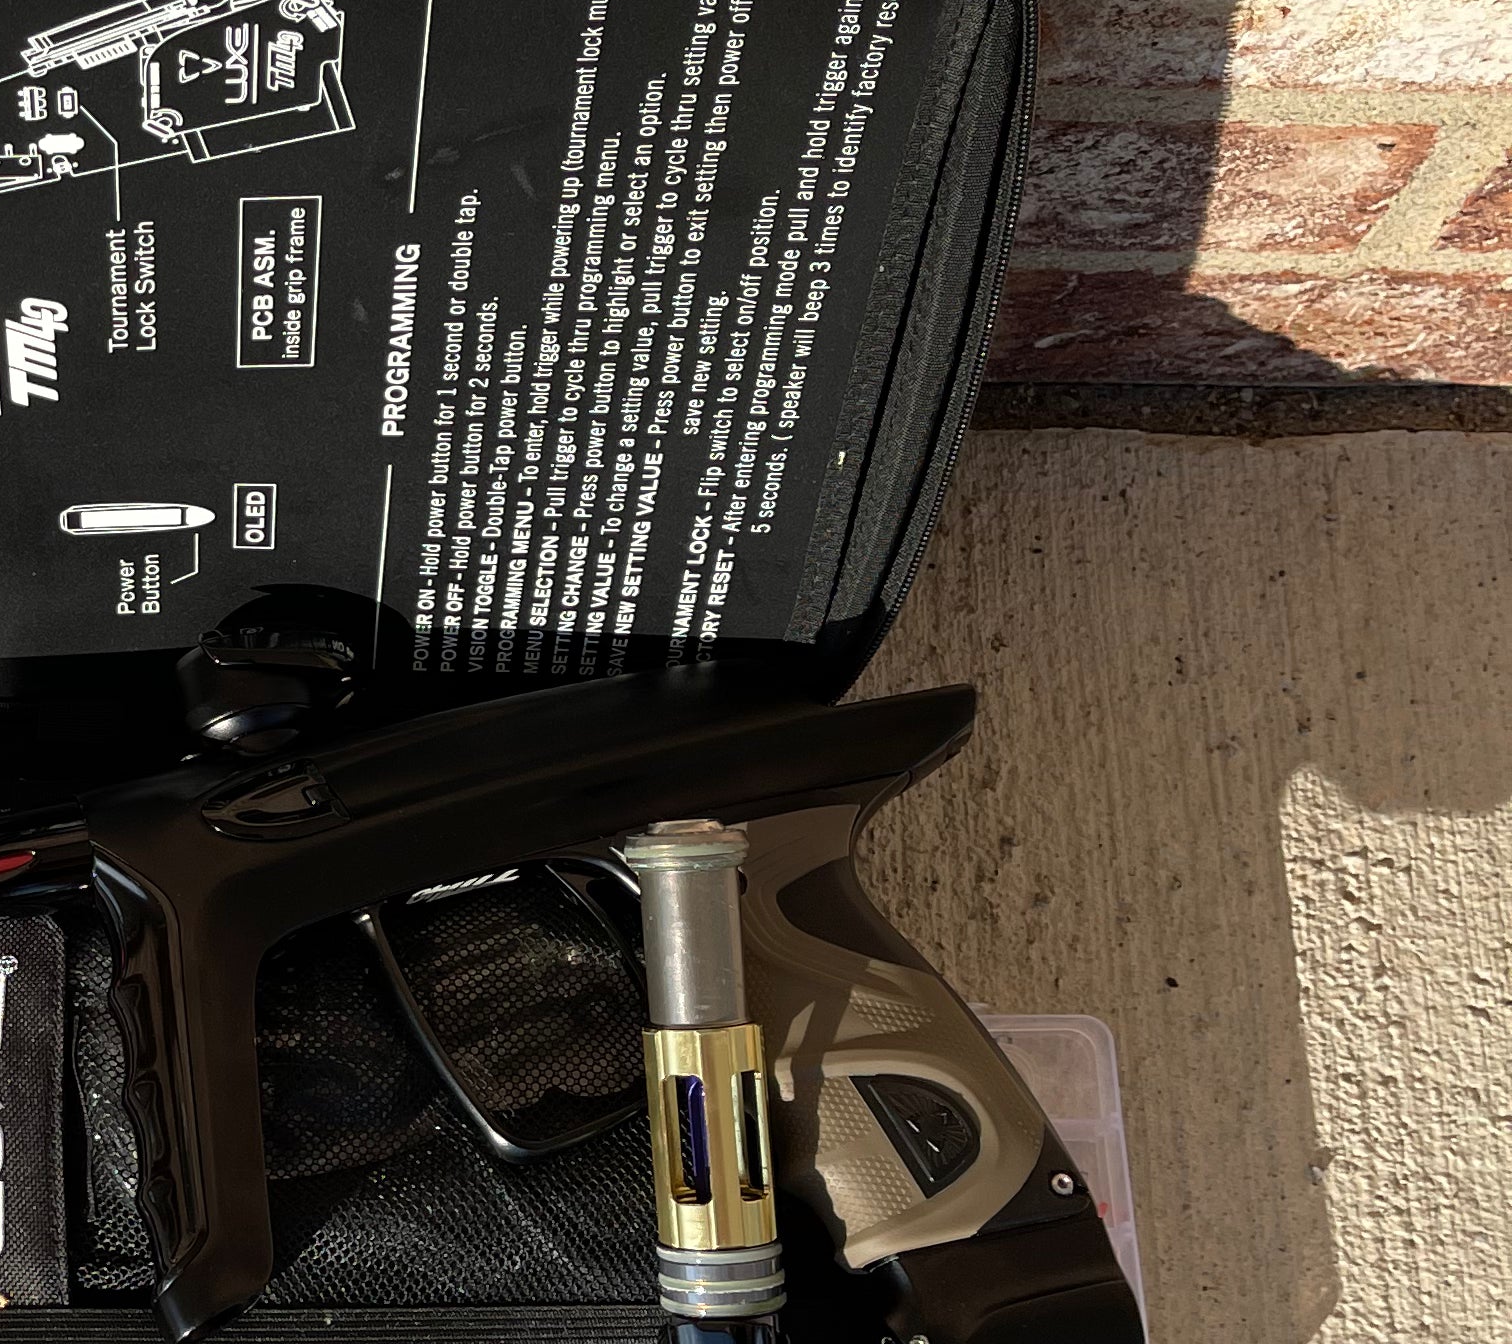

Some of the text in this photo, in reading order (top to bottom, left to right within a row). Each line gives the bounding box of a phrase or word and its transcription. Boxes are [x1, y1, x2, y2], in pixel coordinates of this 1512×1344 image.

[224, 22, 249, 104] LUXE
[579, 26, 604, 62] lock
[855, 34, 894, 97] factory
[563, 67, 598, 171] (tournament
[837, 103, 874, 173] identify
[454, 189, 482, 224] tap.
[561, 177, 584, 198] up
[830, 180, 851, 198] to
[550, 203, 581, 277] powering
[817, 205, 845, 255] times
[133, 221, 157, 351] Lock Switch
[251, 230, 276, 340] PCB ASM.
[281, 207, 307, 359] inside grip frame
[448, 230, 474, 291] double
[814, 261, 831, 273] 3
[105, 228, 129, 353] Tournament
[449, 297, 467, 315] or
[542, 283, 565, 324] while
[800, 279, 831, 321] beep
[381, 244, 421, 436] PROGRAMMING
[442, 322, 464, 381] second
[474, 296, 499, 372] seconds.
[499, 324, 528, 384] button.
[533, 328, 561, 378] trigger
[794, 329, 816, 358] will
[436, 388, 457, 396] 1
[464, 393, 487, 417] for
[468, 378, 490, 388] 2
[527, 382, 551, 414] hold
[778, 363, 807, 429] speaker
[433, 403, 456, 426] for
[497, 390, 519, 438] power
[523, 419, 549, 461] enter,
[427, 432, 453, 484] button
[458, 423, 484, 475] button
[517, 465, 540, 483] To
[457, 481, 477, 529] power
[481, 445, 516, 537] Double-Tap
[758, 447, 789, 518] seconds.
[244, 491, 266, 543] OLED
[427, 490, 447, 538] power
[510, 501, 535, 554] MENU
[750, 523, 771, 533] 5
[418, 543, 441, 576] Hold
[448, 536, 472, 569] Hold
[117, 559, 136, 615] Power
[141, 554, 160, 614] Button
[417, 589, 436, 610] ON
[444, 582, 465, 612] OFF
[473, 554, 499, 615] TOGGLE
[495, 559, 528, 673] PROGRAMMING
[412, 614, 434, 671] POWER
[440, 615, 462, 672] POWER
[467, 618, 490, 673] VISION
